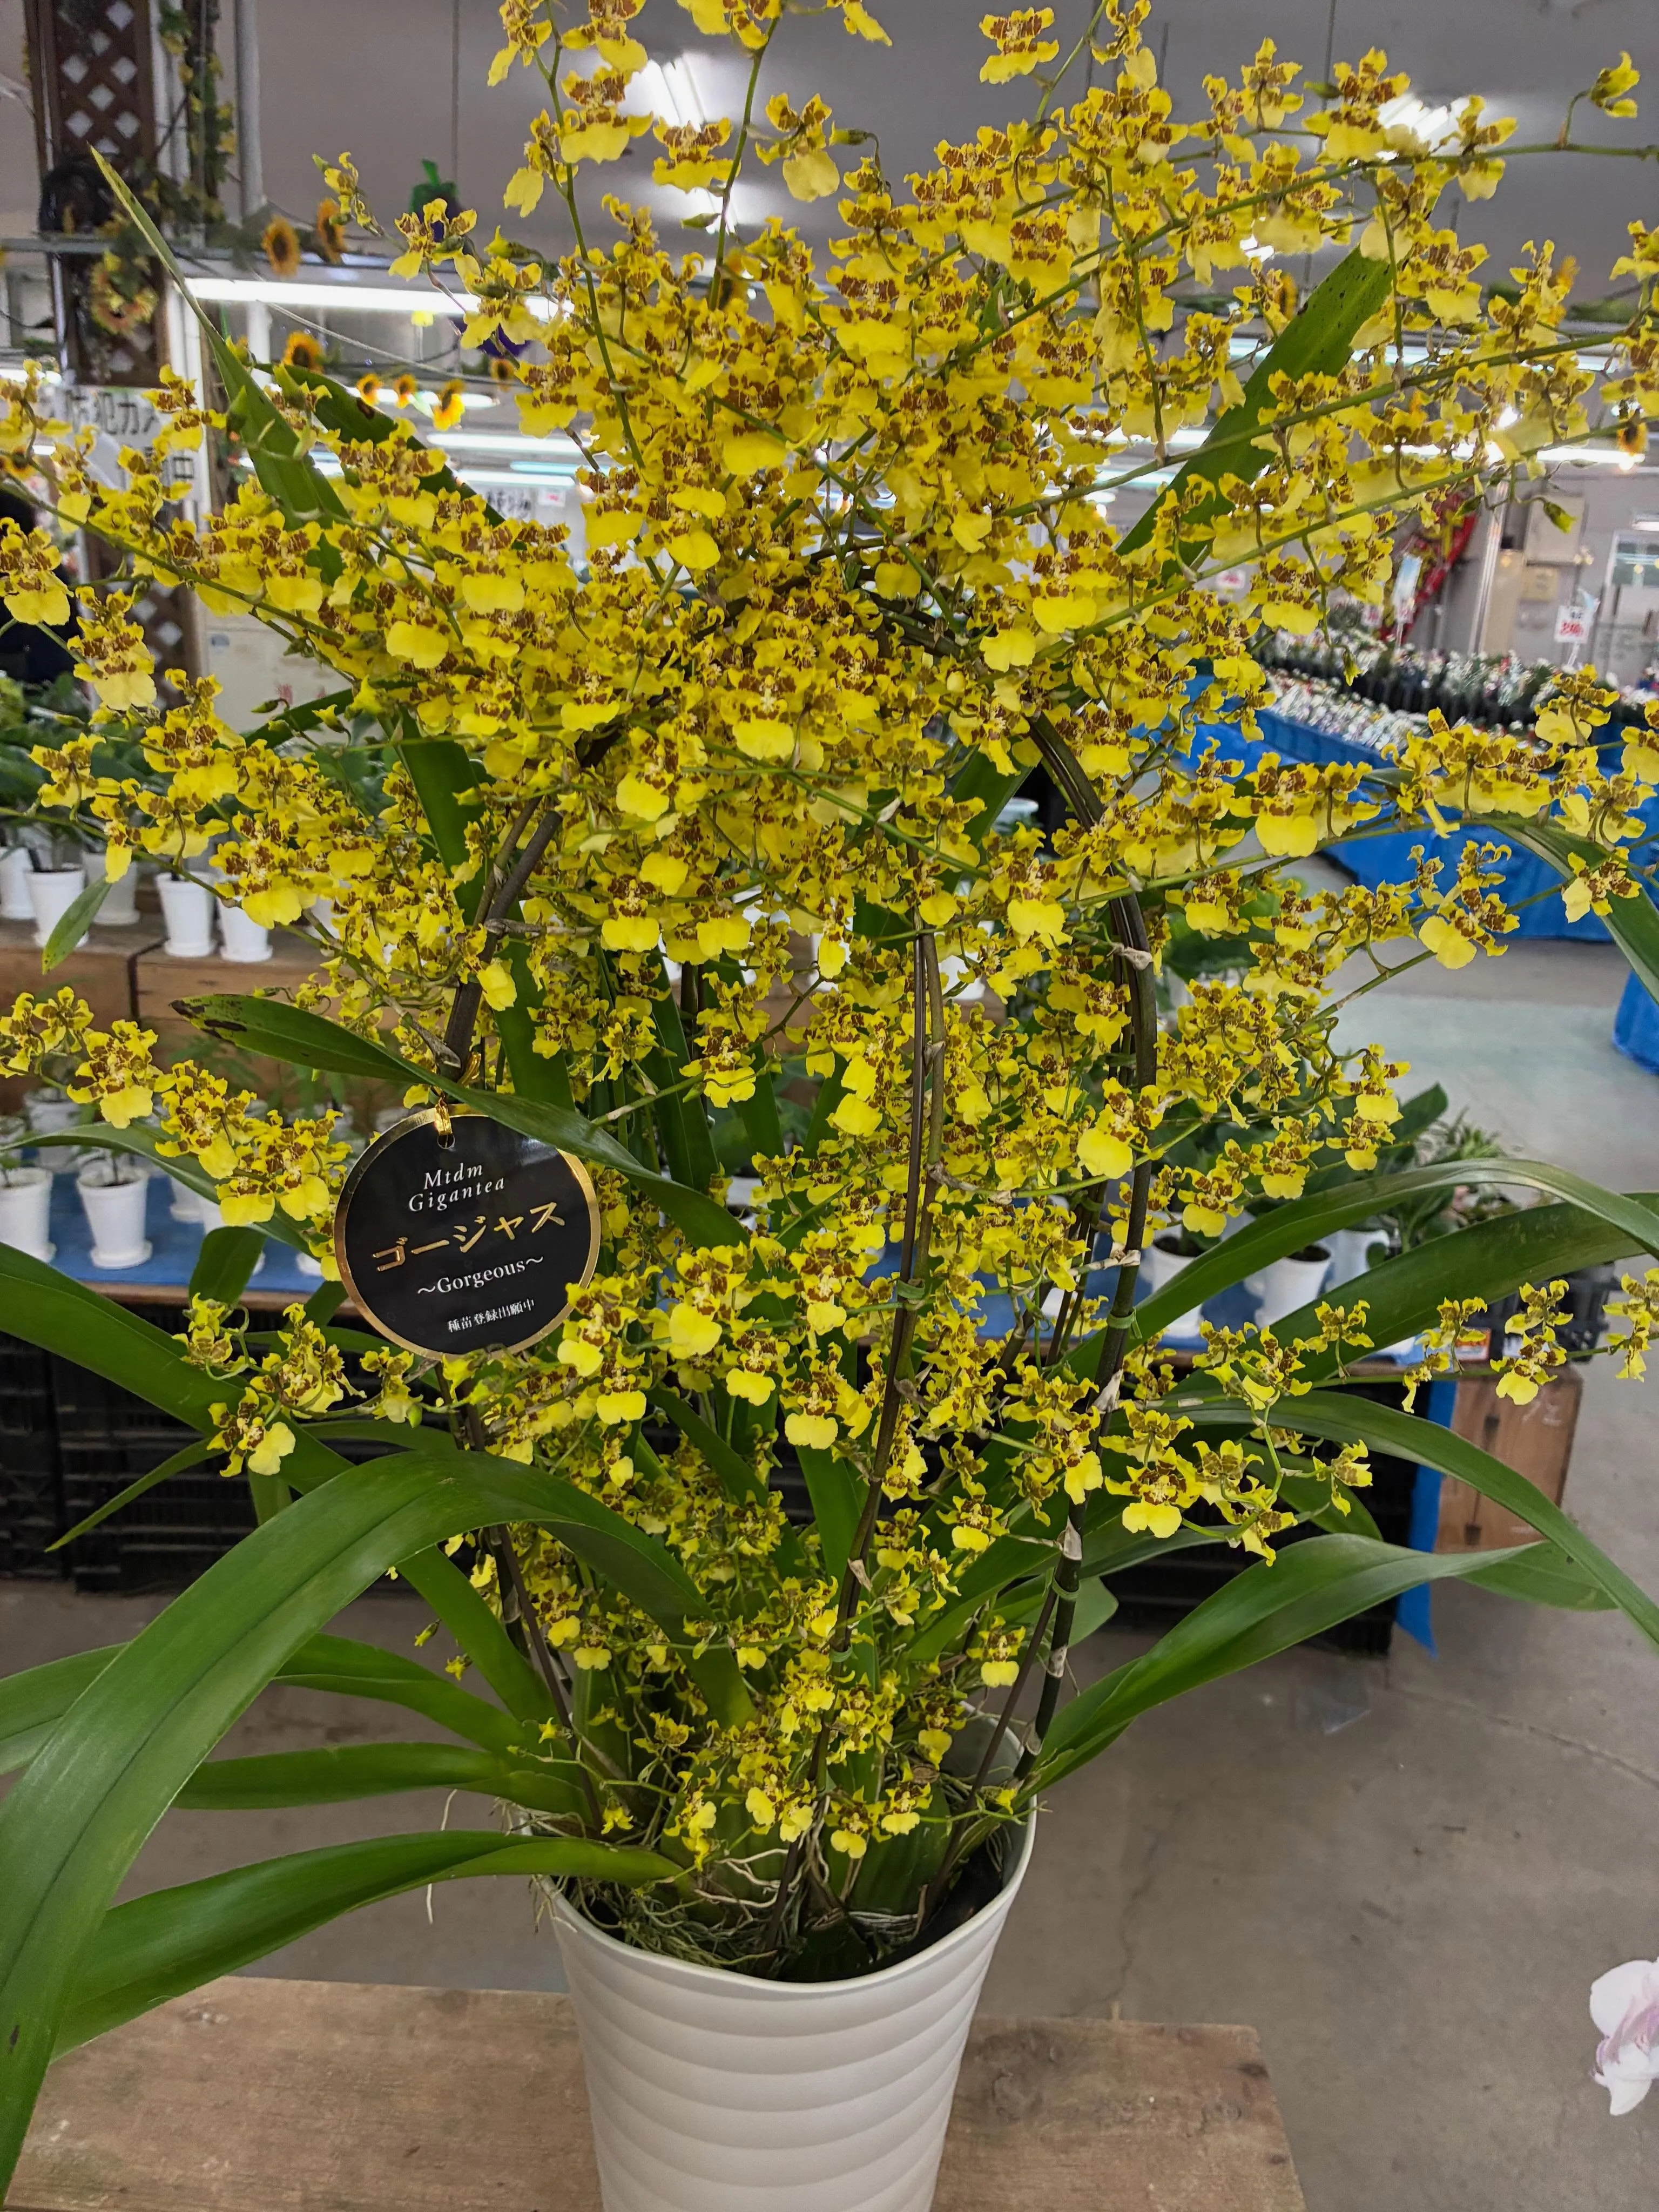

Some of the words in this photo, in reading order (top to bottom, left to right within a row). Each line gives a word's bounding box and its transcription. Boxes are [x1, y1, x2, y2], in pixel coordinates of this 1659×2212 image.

[423, 1162, 483, 1190] Mtdm
[408, 1177, 505, 1212] Gigantea
[372, 1202, 565, 1272] ゴージャス
